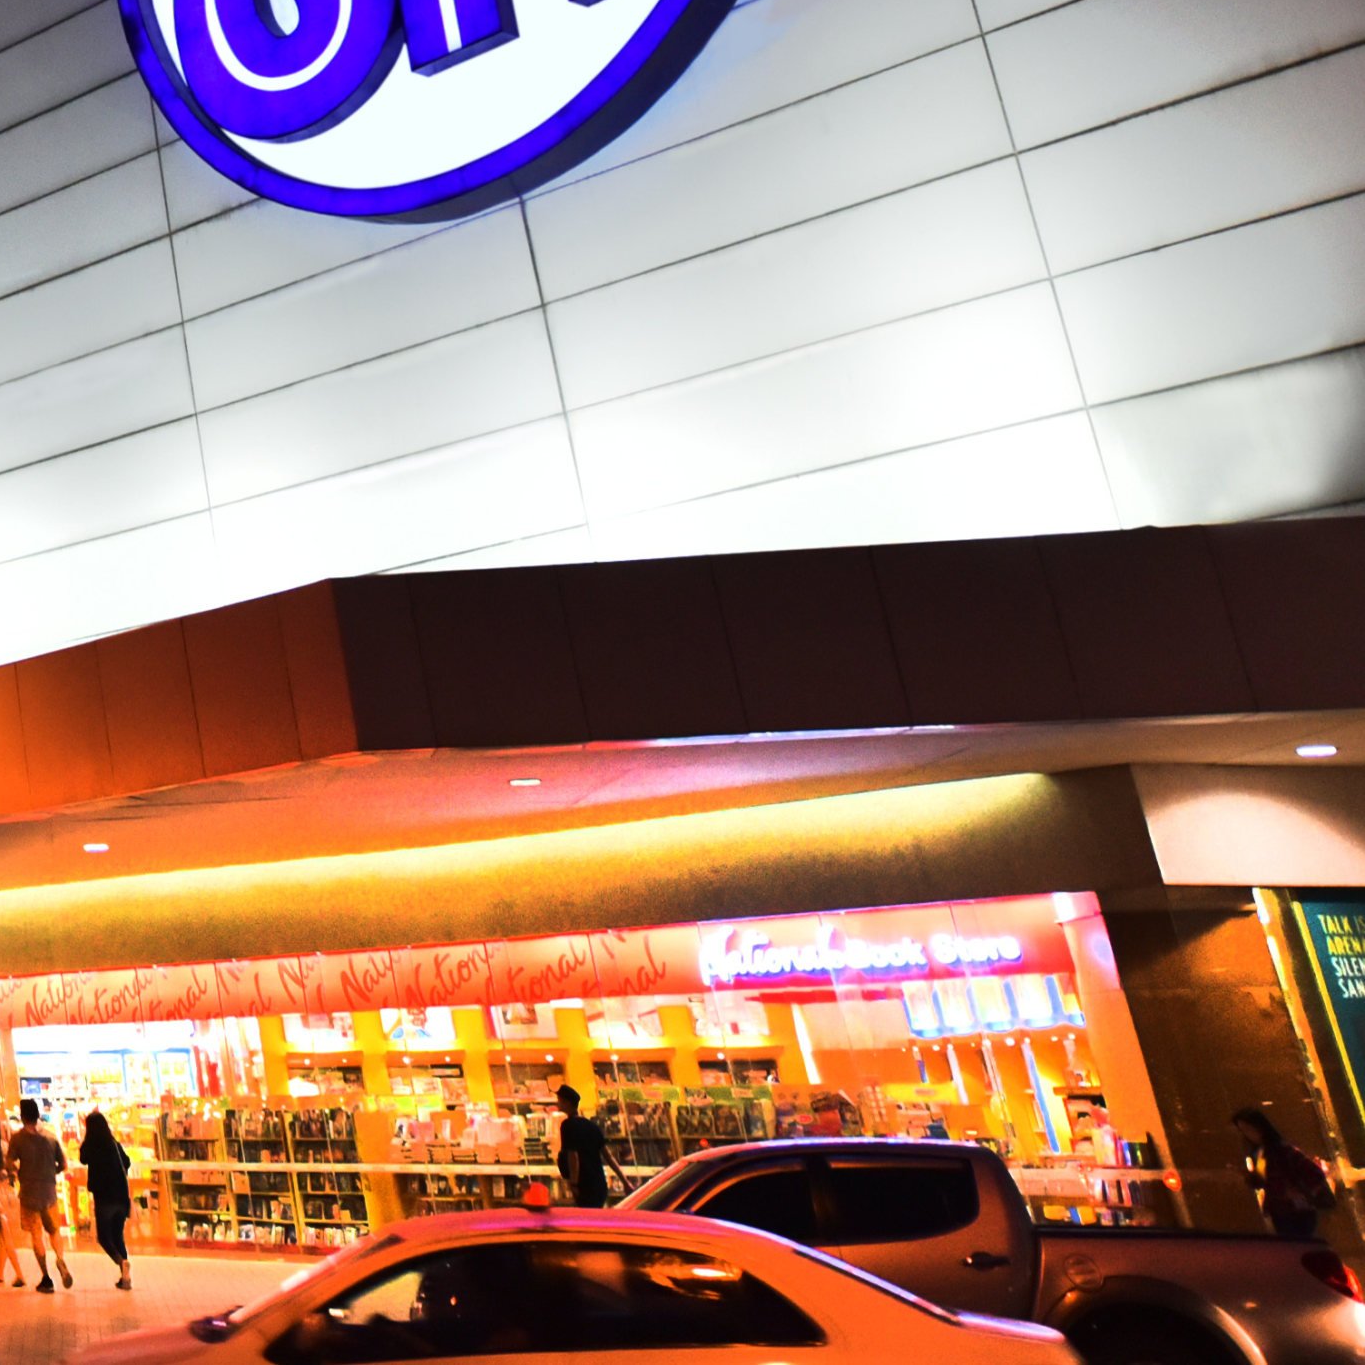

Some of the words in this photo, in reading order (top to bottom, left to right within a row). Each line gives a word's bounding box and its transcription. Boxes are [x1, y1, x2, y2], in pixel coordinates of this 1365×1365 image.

[1317, 914, 1353, 935] TALK
[699, 923, 843, 986] National
[843, 938, 928, 970] Book
[929, 932, 1022, 965] Store
